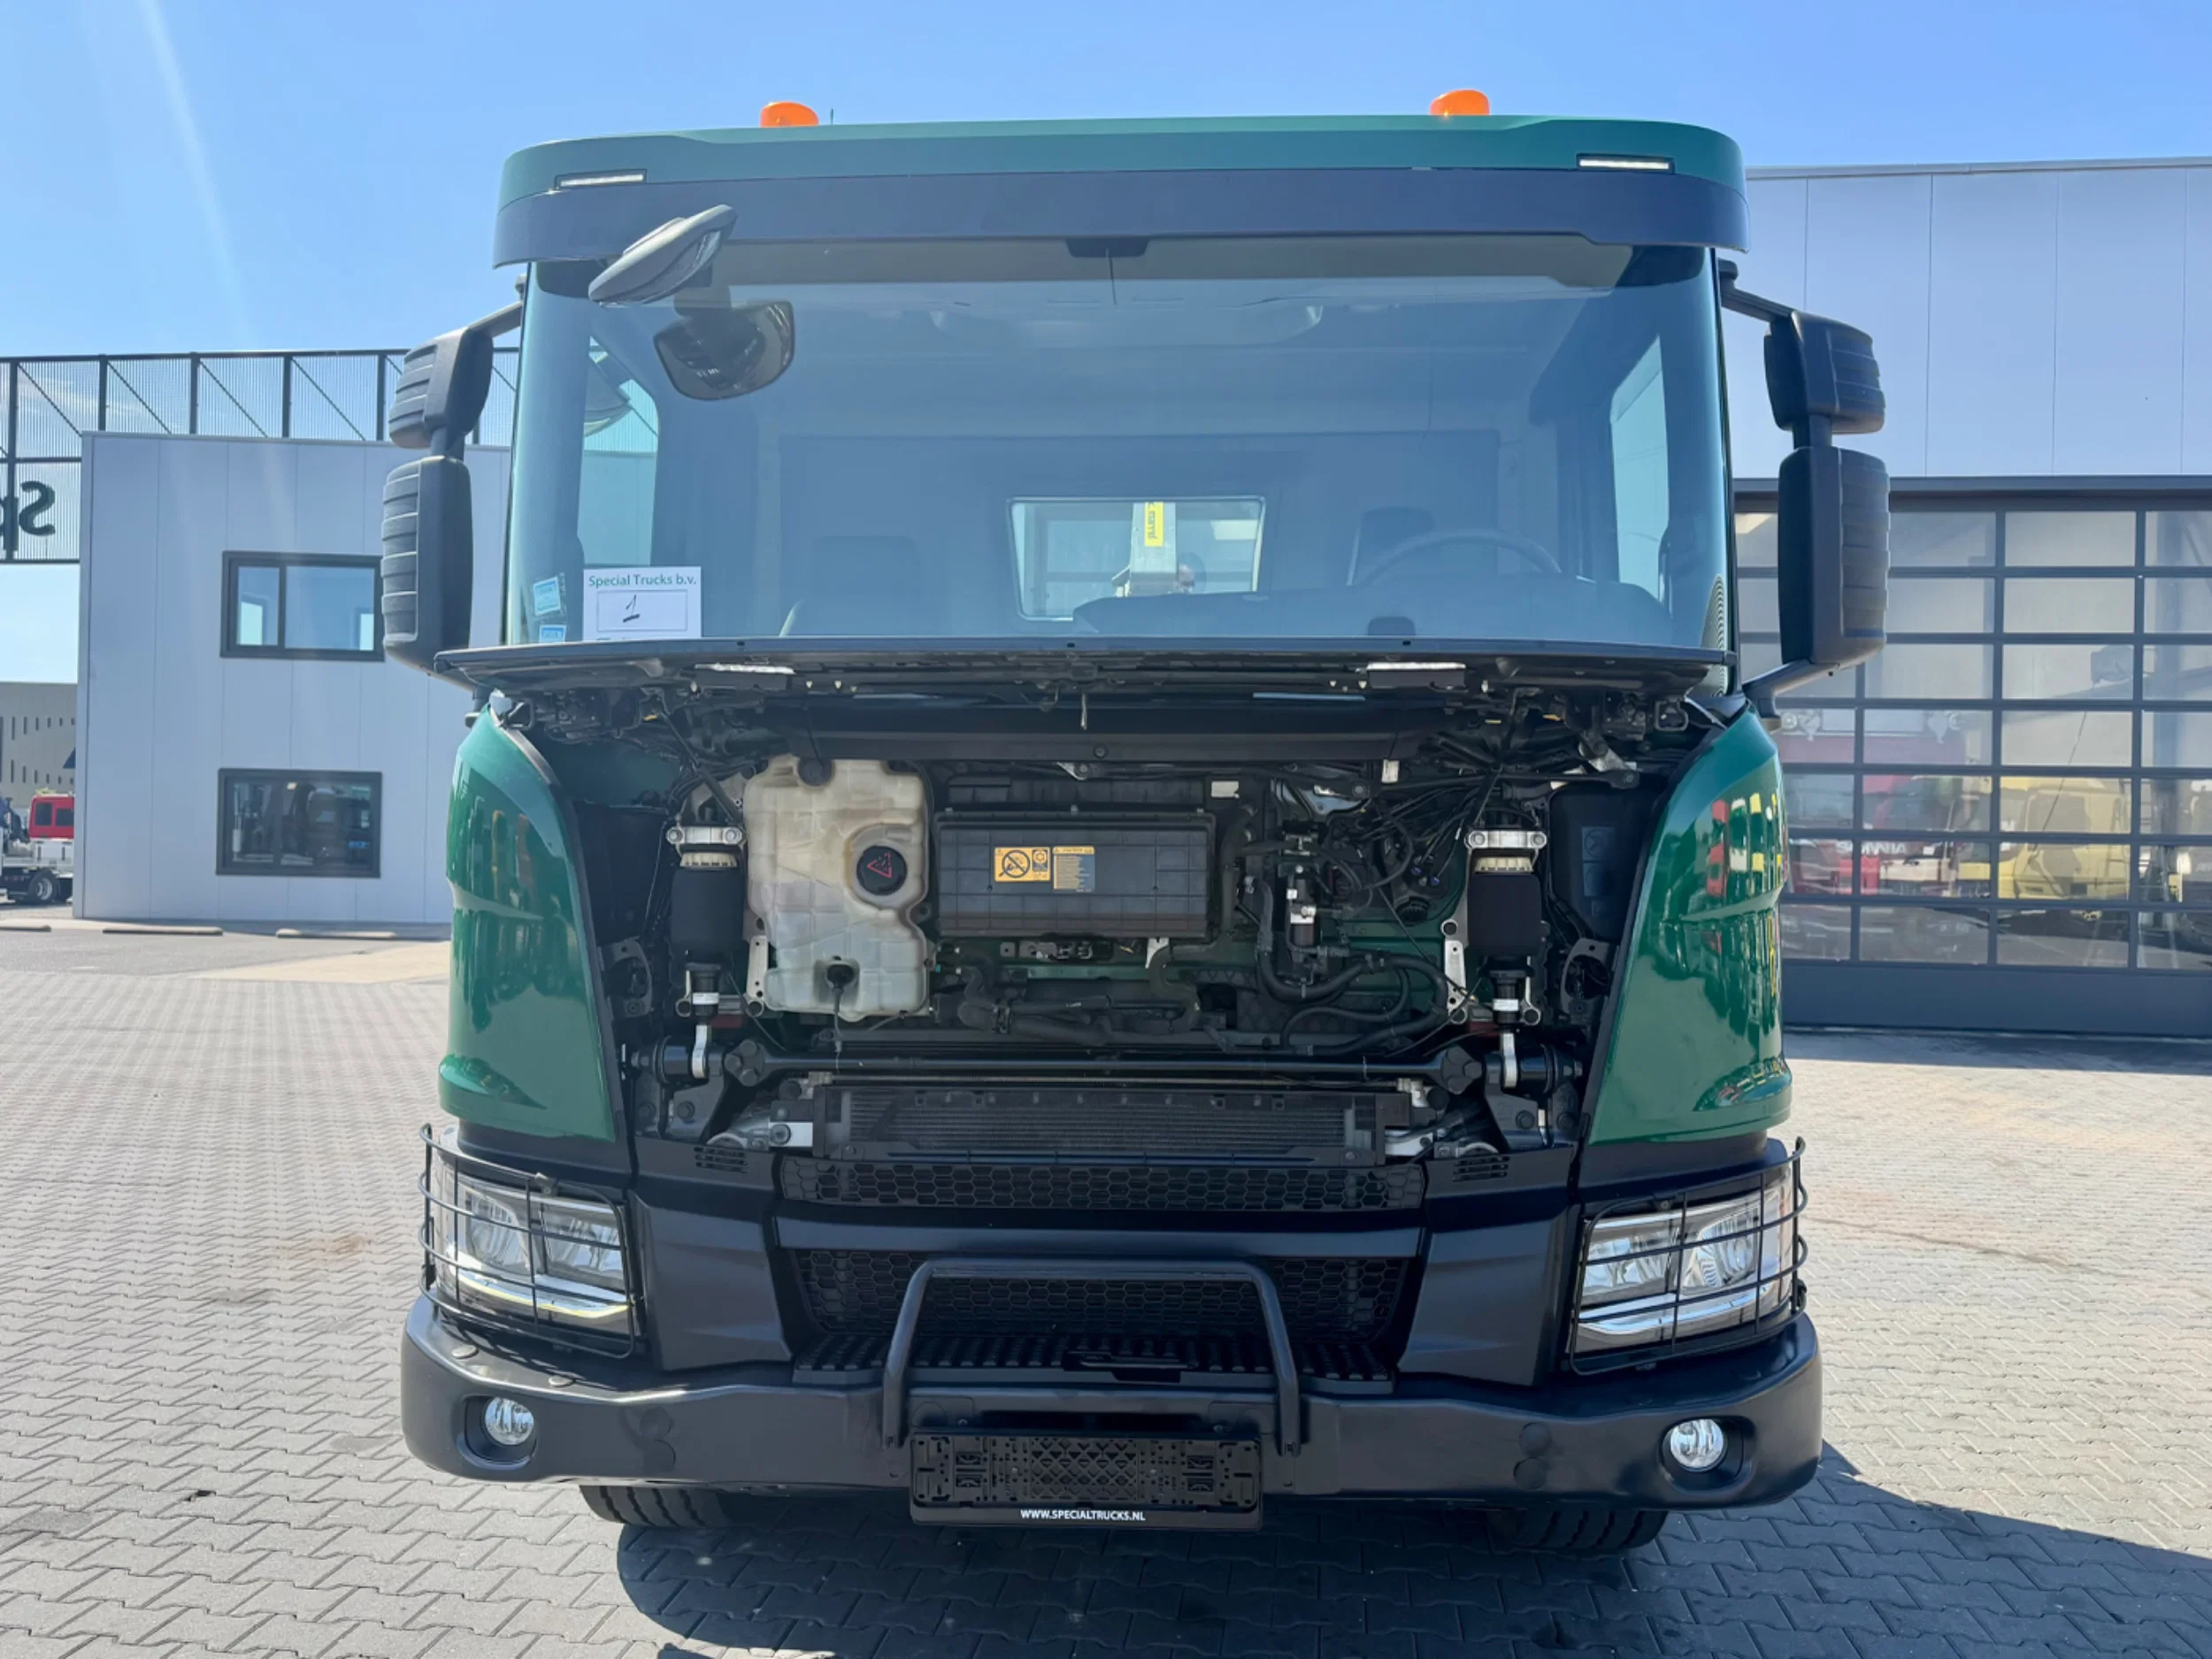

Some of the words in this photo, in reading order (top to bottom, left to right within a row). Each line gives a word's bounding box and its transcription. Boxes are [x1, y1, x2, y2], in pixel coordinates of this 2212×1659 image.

[588, 574, 630, 588] Special
[634, 573, 672, 585] Trucks
[676, 572, 696, 585] b.v.
[1020, 1509, 1146, 1521] WWW.SPECIALTRUCKS.NL
